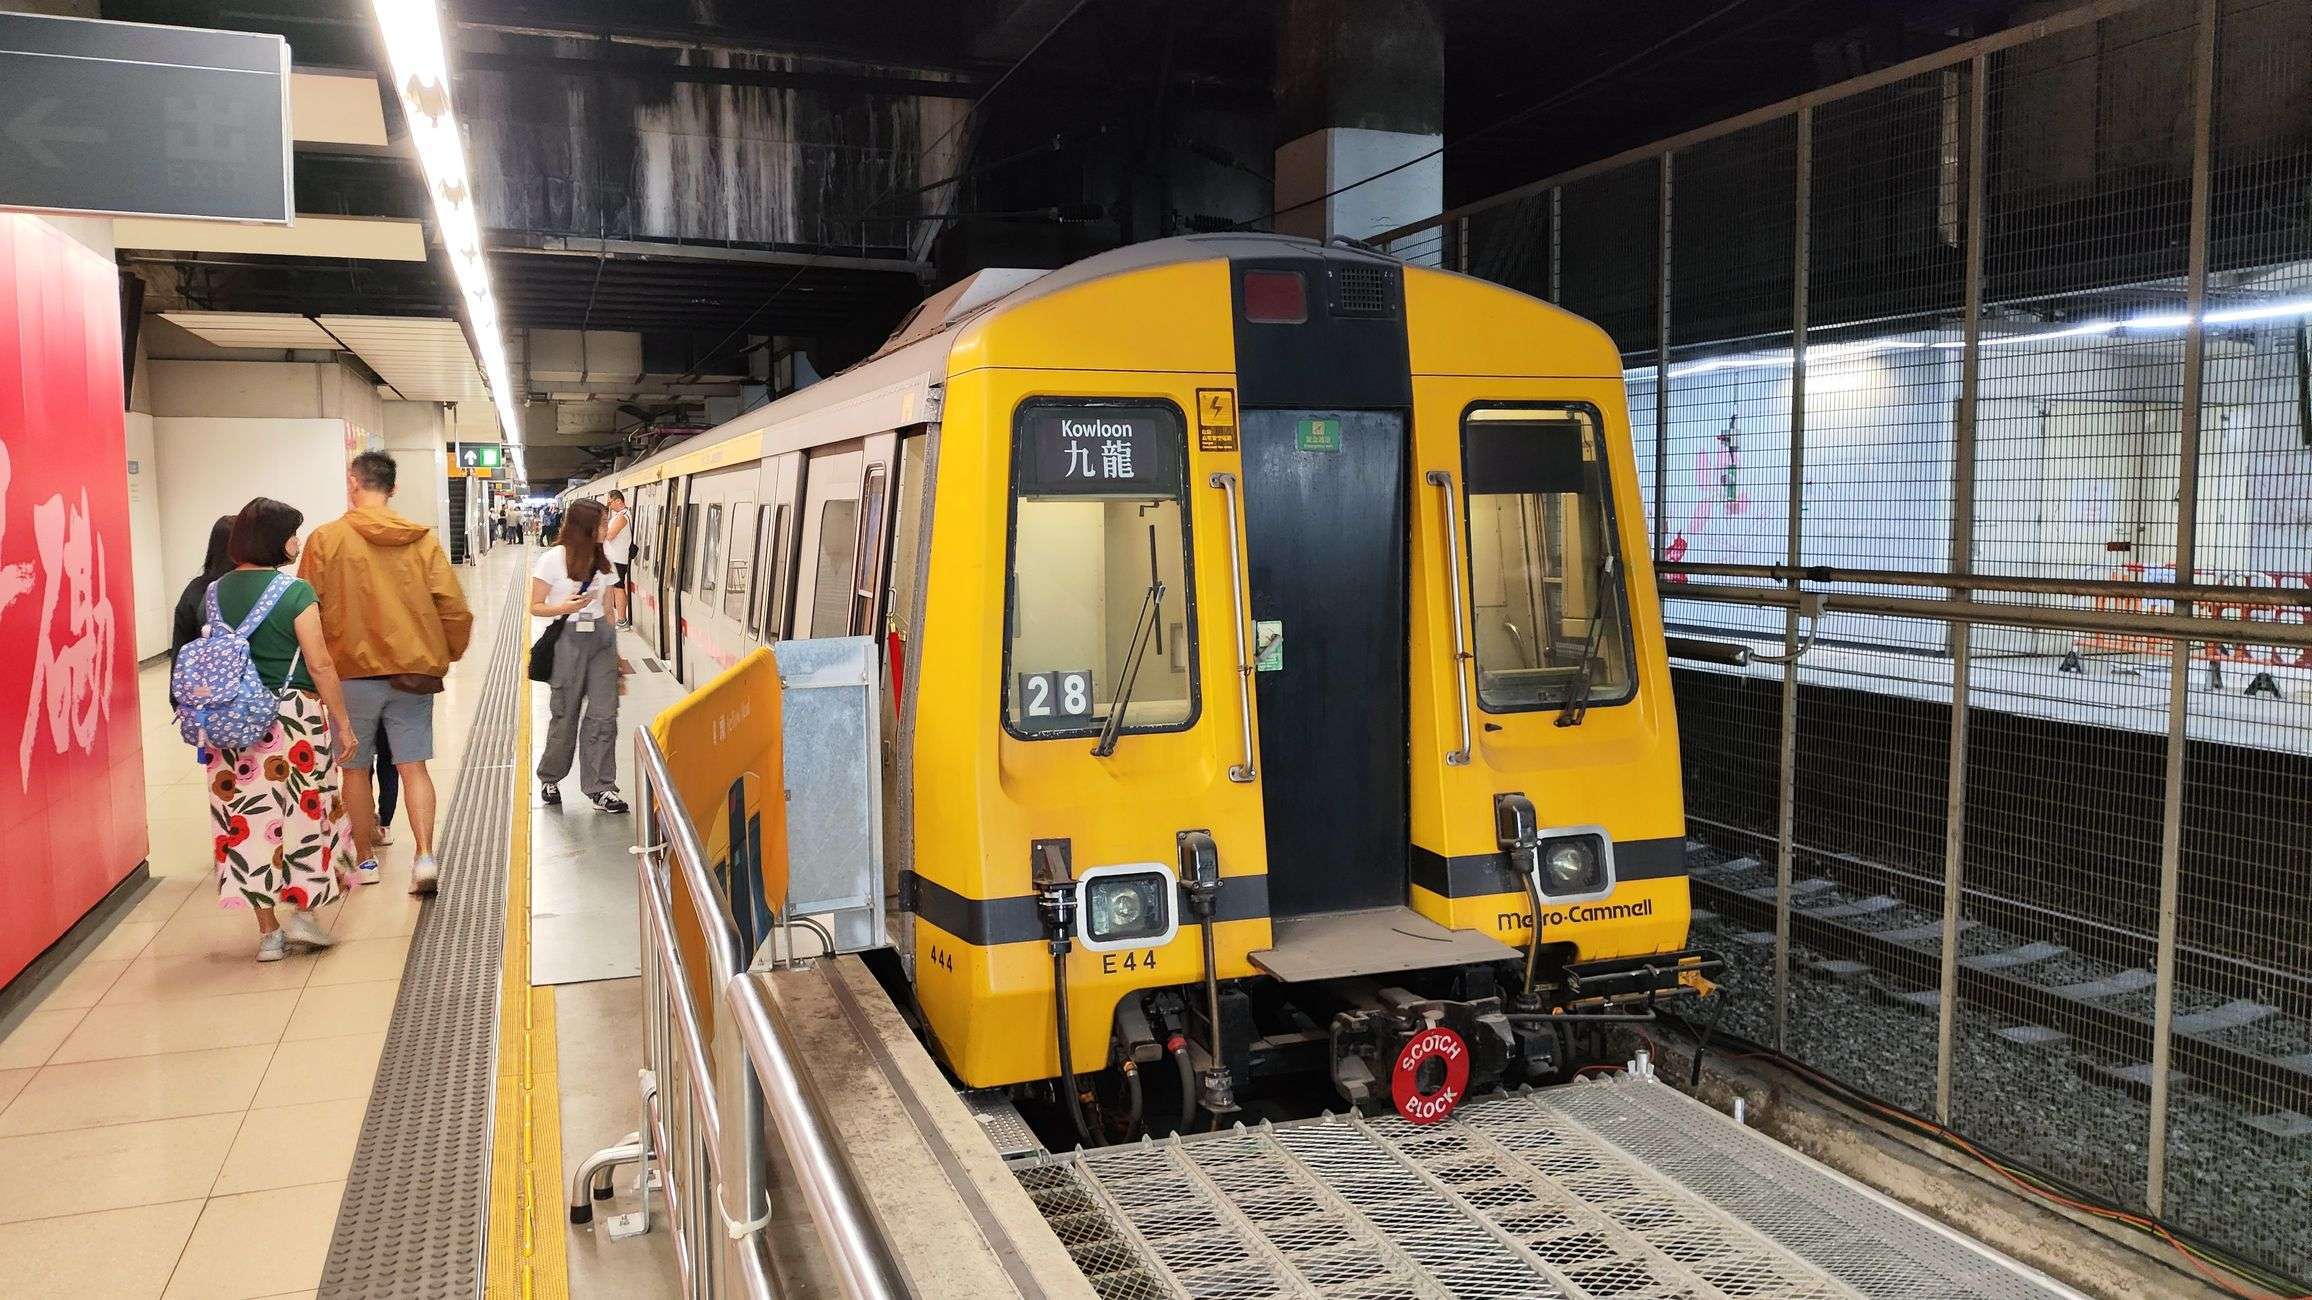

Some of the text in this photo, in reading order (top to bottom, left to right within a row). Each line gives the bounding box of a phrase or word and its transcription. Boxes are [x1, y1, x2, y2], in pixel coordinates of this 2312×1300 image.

[1061, 419, 1133, 438] Kowloon
[1063, 439, 1135, 479] 九龍
[1027, 674, 1087, 717] 28
[930, 944, 953, 973] 444
[1102, 949, 1157, 975] E44
[1402, 1034, 1462, 1072] SCOTCH
[1405, 1086, 1458, 1118] BLOCK
